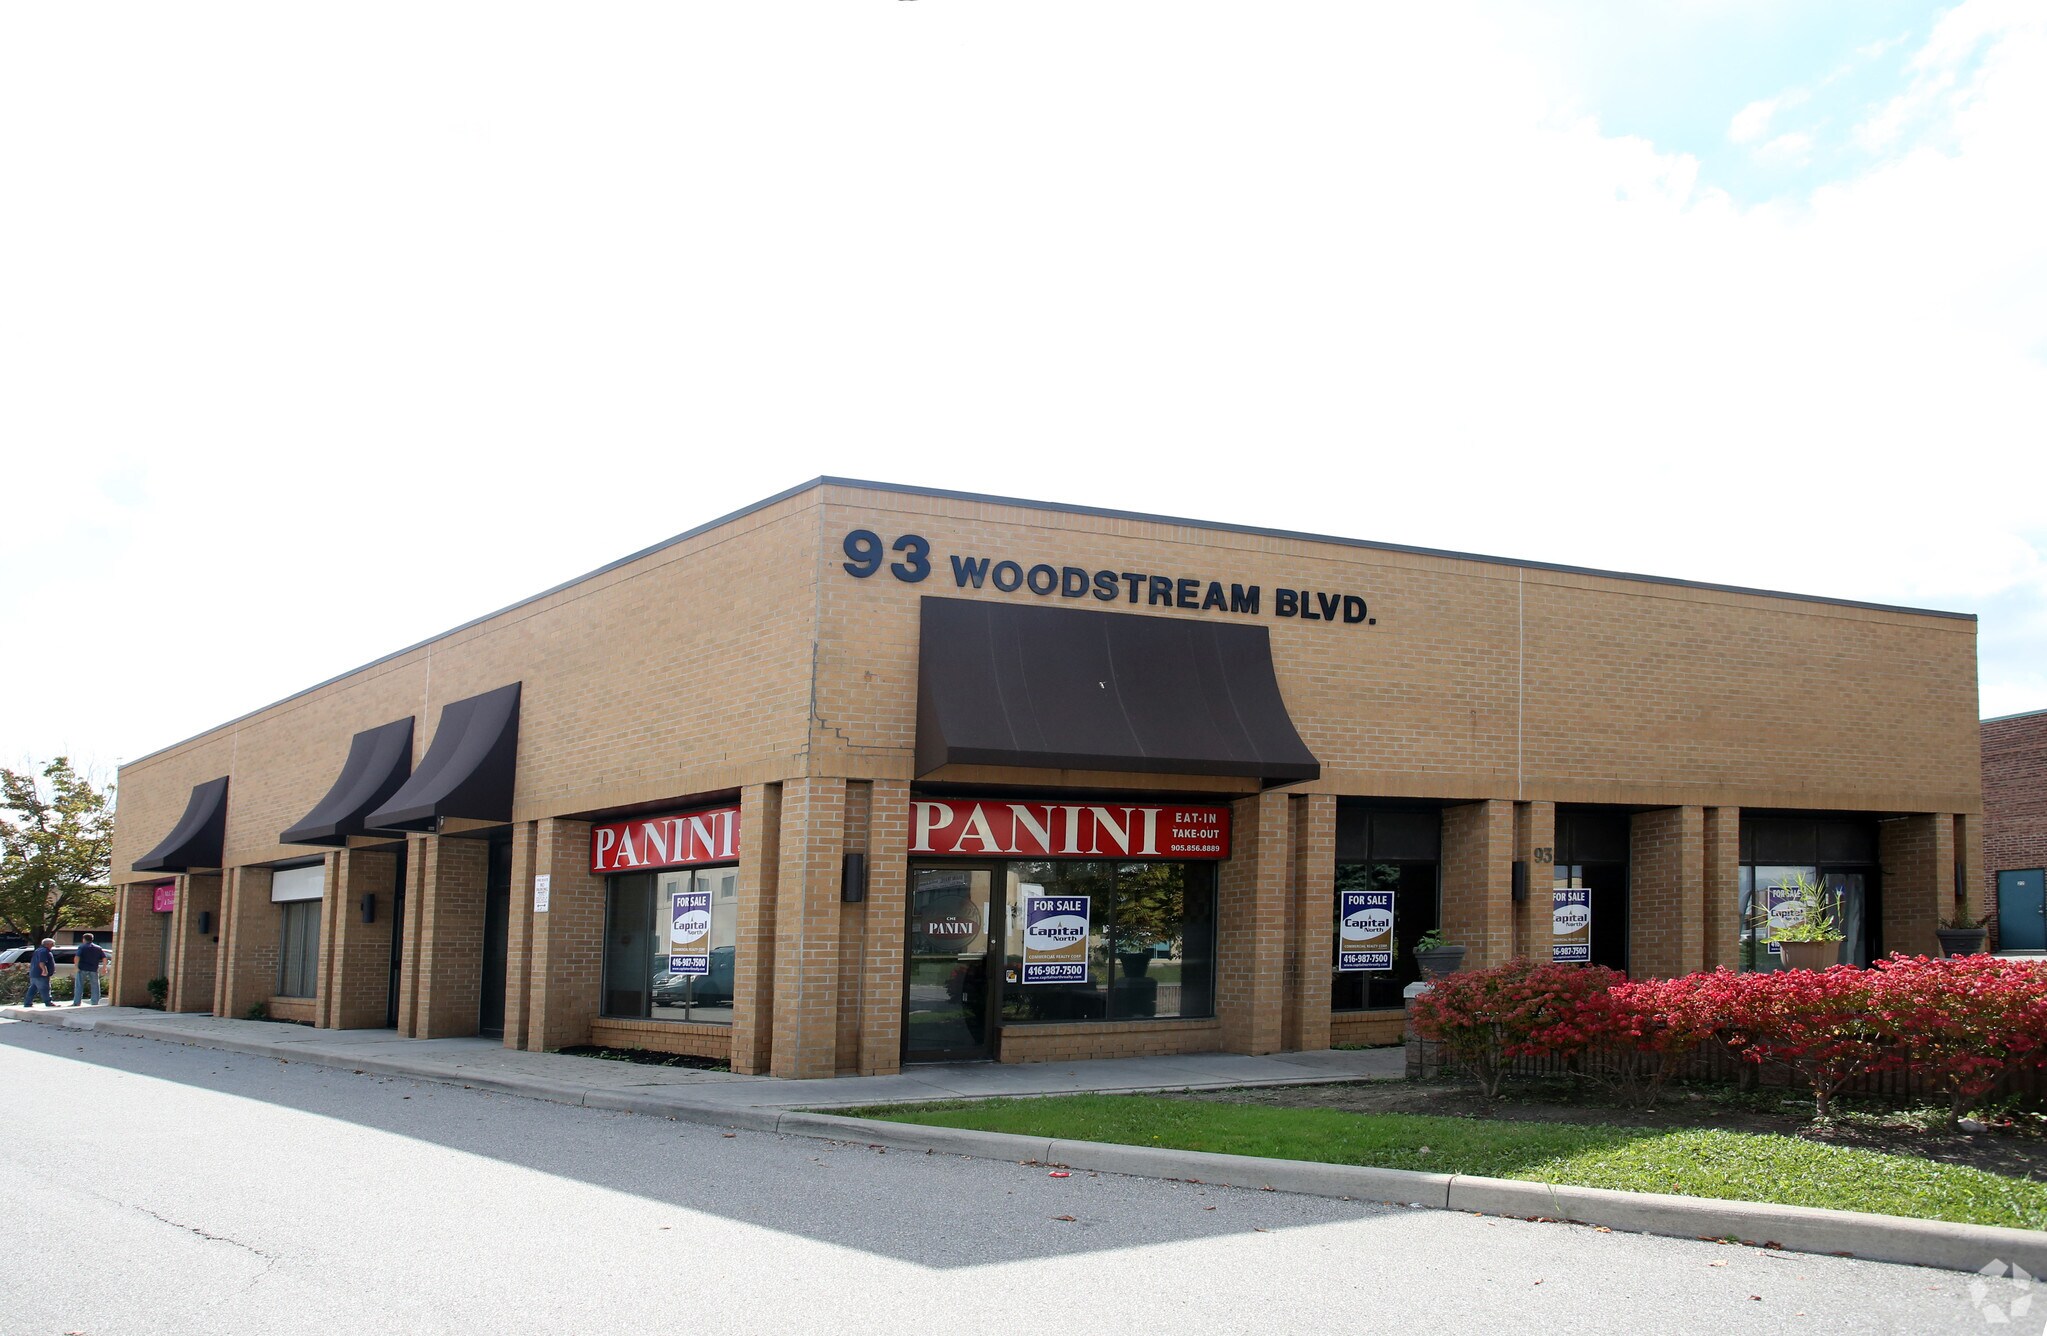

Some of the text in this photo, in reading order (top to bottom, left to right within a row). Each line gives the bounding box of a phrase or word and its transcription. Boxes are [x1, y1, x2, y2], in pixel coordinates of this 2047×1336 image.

[843, 529, 1377, 625] 93 WOODSTREAM BLVD.
[909, 800, 1163, 856] PANINI
[594, 810, 737, 870] PANINI
[1533, 847, 1553, 864] 93
[1553, 892, 1585, 901] FOR SALE
[1772, 889, 1785, 898] FOR
[676, 896, 706, 907] FOR SALE
[1034, 900, 1081, 911] FOR SALE
[1348, 895, 1387, 905] FOR SALE
[1344, 918, 1390, 929] Capital
[1553, 914, 1587, 924] apital
[674, 921, 707, 932] Capital
[929, 922, 973, 934] PANINI
[1029, 926, 1084, 938] Capital
[1553, 946, 1587, 955] 16-987-7500
[672, 957, 706, 967] 416-987-7500
[1343, 954, 1388, 963] 416-987-7500
[1028, 965, 1082, 976] 416-987-7500
